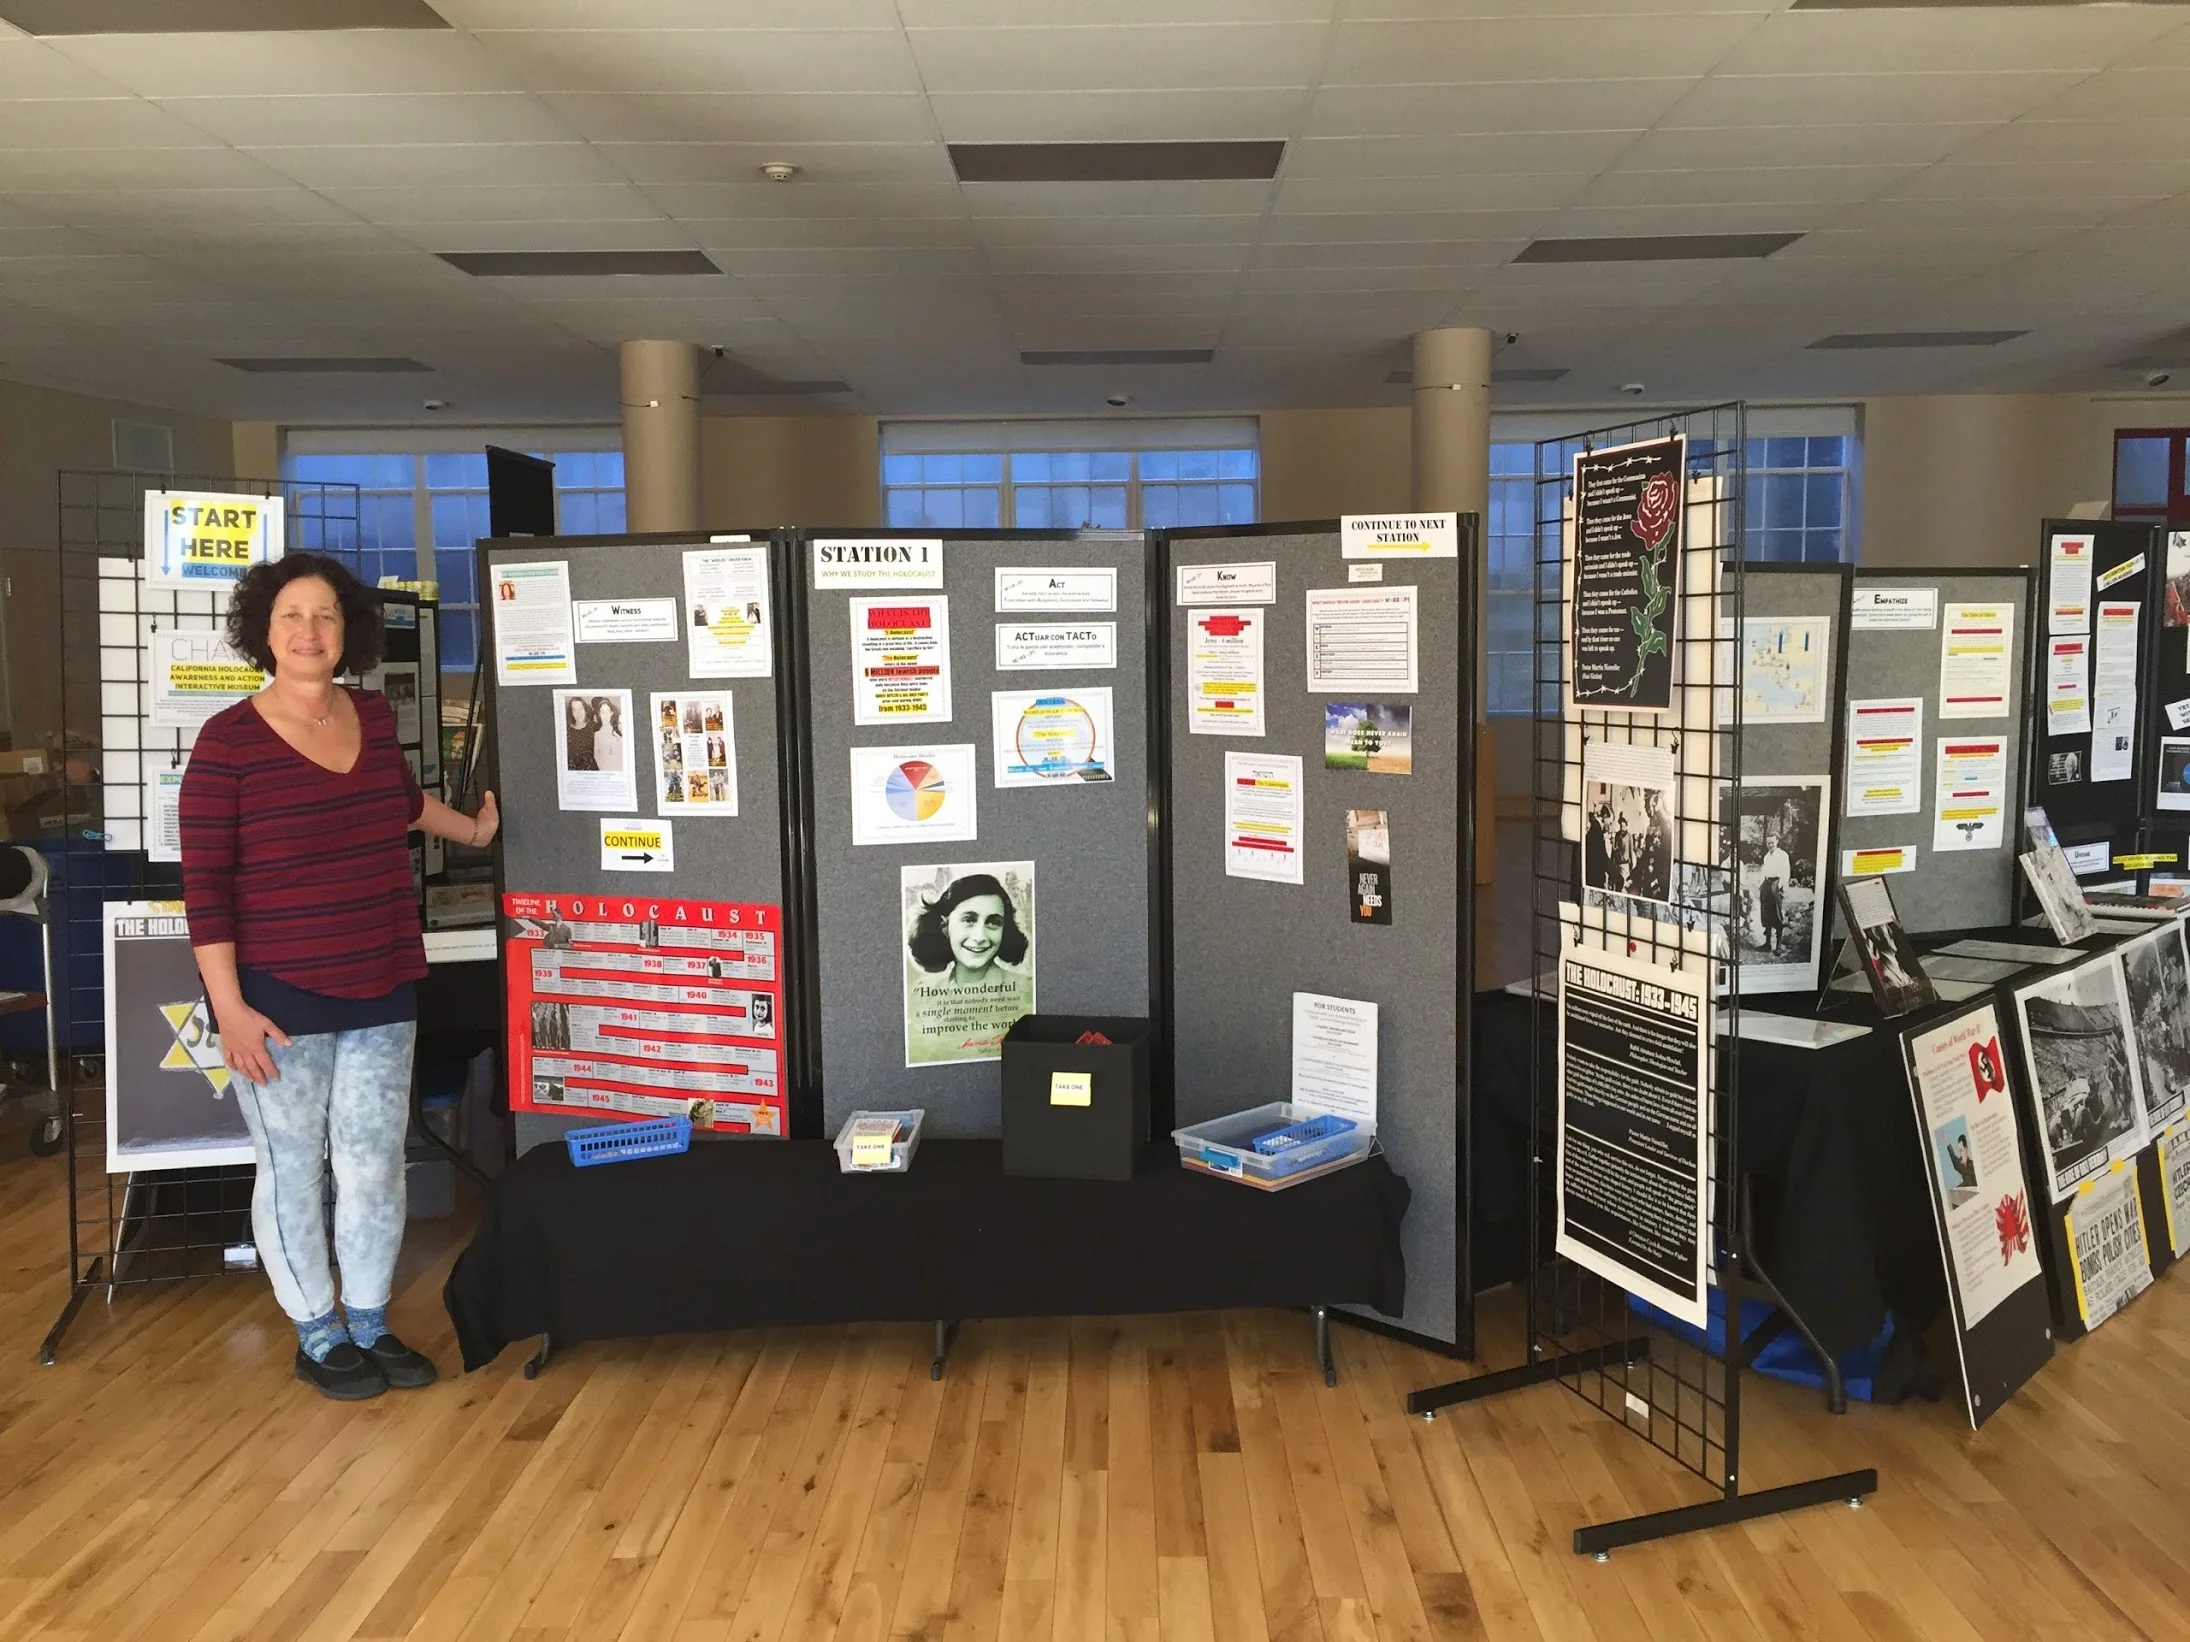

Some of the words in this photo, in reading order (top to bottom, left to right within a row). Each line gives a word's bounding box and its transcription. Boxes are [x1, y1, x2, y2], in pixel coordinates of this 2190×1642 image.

[172, 506, 256, 528] START
[1352, 521, 1402, 531] CONTINUE
[1405, 520, 1417, 530] TO
[1420, 519, 1447, 529] NEXT
[1377, 533, 1420, 542] STATION
[181, 538, 248, 558] HERE
[820, 546, 912, 563] STATION
[922, 546, 928, 562] 1
[1217, 571, 1236, 580] KNOW
[1049, 579, 1065, 588] ACT
[1874, 594, 1908, 604] EMPATHIZE
[611, 605, 641, 614] WITNESS
[1015, 632, 1049, 641] ACTUAR
[1066, 631, 1097, 640] TACTO
[895, 704, 927, 712] 1933-1945
[605, 836, 661, 848] CONTINUE
[1360, 873, 1378, 885] NEVER
[1358, 884, 1375, 894] AGAIN
[512, 898, 540, 906] TIMELINE
[1363, 895, 1382, 907] NEEDS
[1360, 905, 1372, 916] YOU
[117, 919, 144, 936] THE
[745, 932, 764, 940] 1935
[644, 960, 662, 968] 1938
[687, 961, 706, 969] 1937
[748, 956, 767, 964] 1936
[953, 981, 1016, 995] wonderful
[1567, 962, 1582, 985] THE
[1584, 966, 1640, 1003] HOLOCAUST:
[1641, 983, 1697, 1019] 1933-1945
[687, 991, 707, 999] 1940
[922, 1007, 952, 1019] single
[954, 1005, 993, 1015] moment
[1314, 1002, 1326, 1010] FOR
[1327, 1004, 1355, 1014] STUDENTS
[620, 1013, 637, 1021] 1941
[922, 1024, 968, 1036] improve
[971, 1021, 988, 1030] the
[1954, 1030, 1966, 1046] World
[1966, 1026, 1976, 1039] War
[644, 1045, 661, 1053] 1942
[574, 1064, 592, 1072] 1944
[754, 1078, 774, 1087] 1943
[592, 1095, 610, 1103] 1945
[2075, 1224, 2100, 1258] HITLER
[2101, 1208, 2122, 1240] OPENS
[2079, 1249, 2102, 1283] BOMBS
[2103, 1234, 2123, 1266] POLISH
[2124, 1220, 2141, 1250] CITIES
